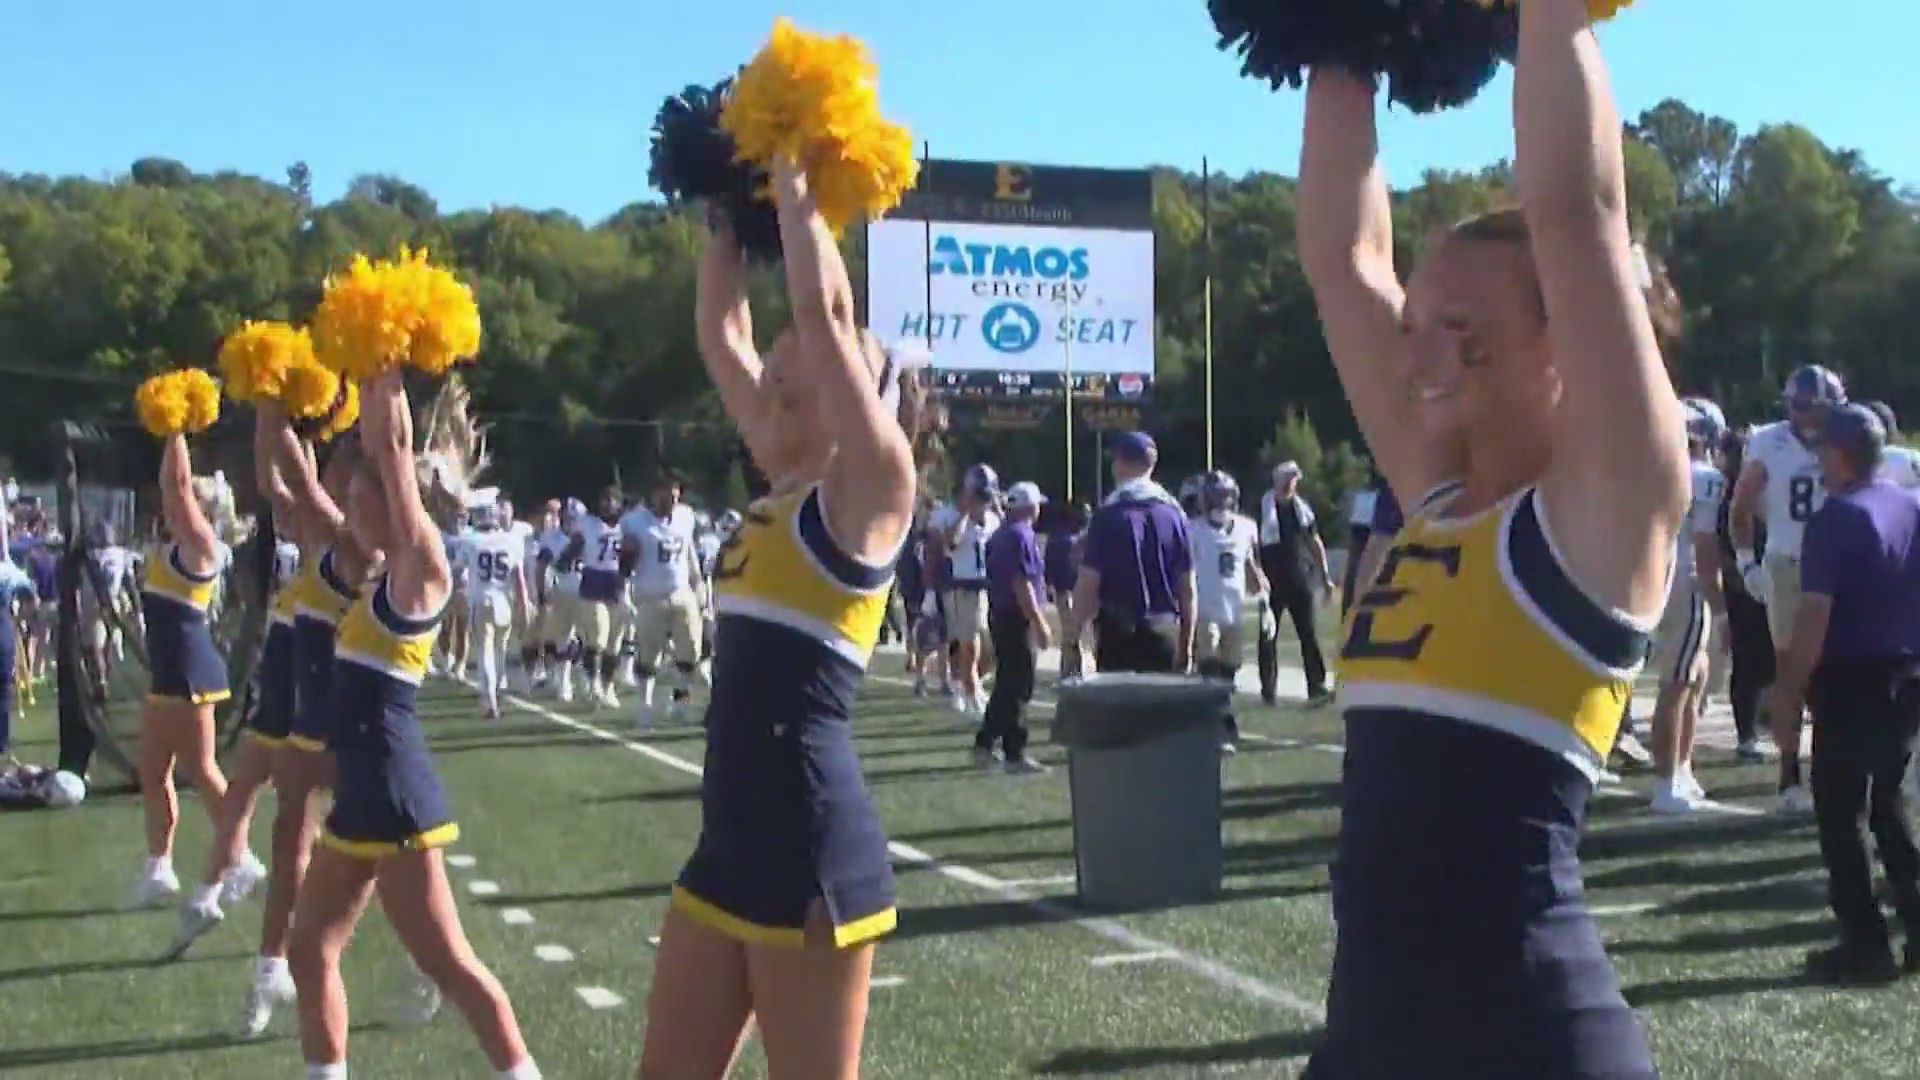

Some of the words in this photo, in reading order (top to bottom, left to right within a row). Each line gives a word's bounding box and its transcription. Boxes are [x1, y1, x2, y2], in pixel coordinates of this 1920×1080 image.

[928, 235, 1090, 281] ATMOS
[971, 279, 1088, 305] energy
[900, 310, 968, 340] HOT
[1055, 316, 1138, 345] SEAT
[477, 550, 509, 582] 95
[1340, 542, 1461, 661] E
